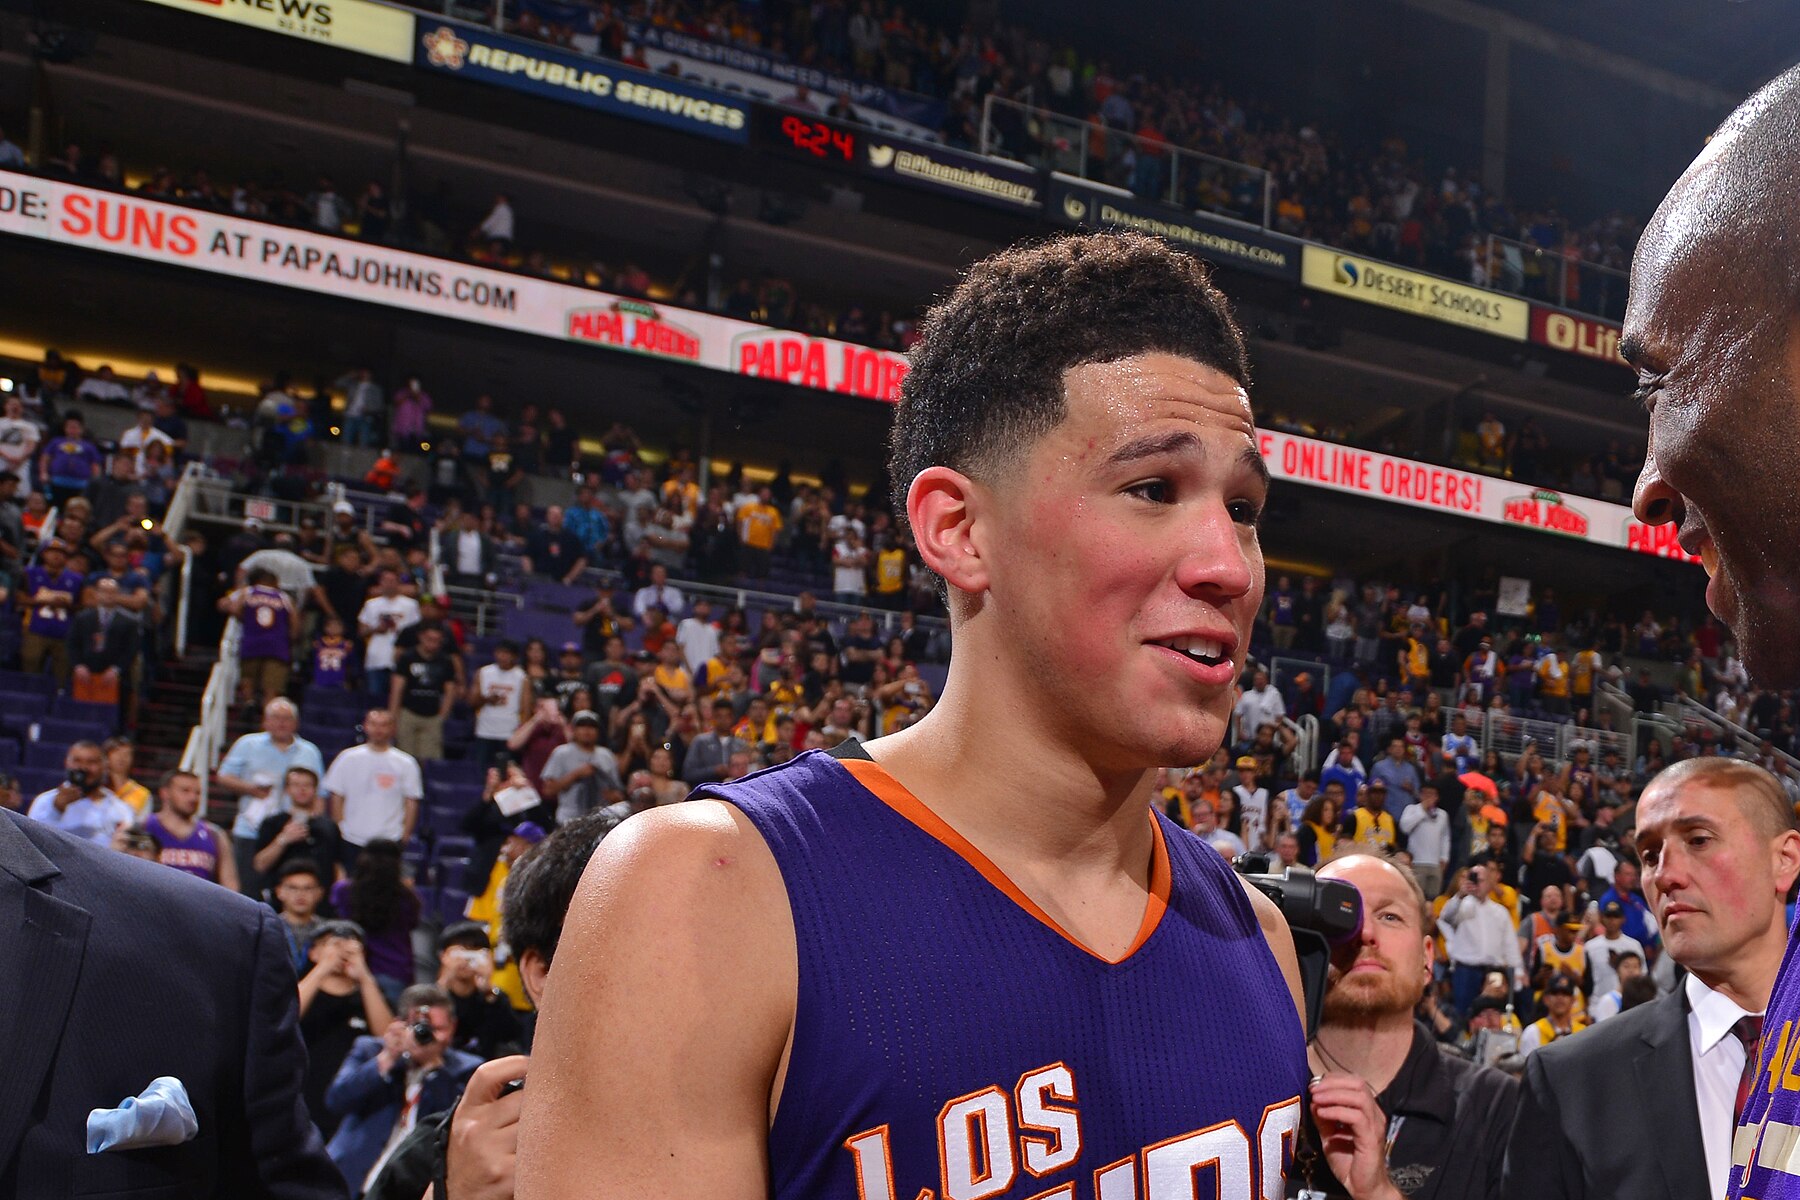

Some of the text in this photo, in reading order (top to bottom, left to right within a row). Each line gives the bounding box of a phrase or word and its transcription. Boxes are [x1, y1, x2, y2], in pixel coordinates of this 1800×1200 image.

[228, 0, 333, 26] EWS
[469, 44, 613, 98] REPUBLIC
[614, 79, 746, 131] SERVICES
[781, 115, 855, 161] 9:24
[60, 193, 198, 256] SUNS
[210, 230, 251, 259] AT
[261, 238, 516, 312] PAPAJOHNS.COM
[1363, 267, 1424, 303] DESERT
[1430, 284, 1502, 322] SCHOOLS
[569, 311, 625, 345] PAPA
[739, 337, 828, 392] PAPA
[1282, 439, 1371, 491] ONLINE
[1380, 460, 1483, 514] ORDERS!
[1502, 501, 1541, 526] PAPA
